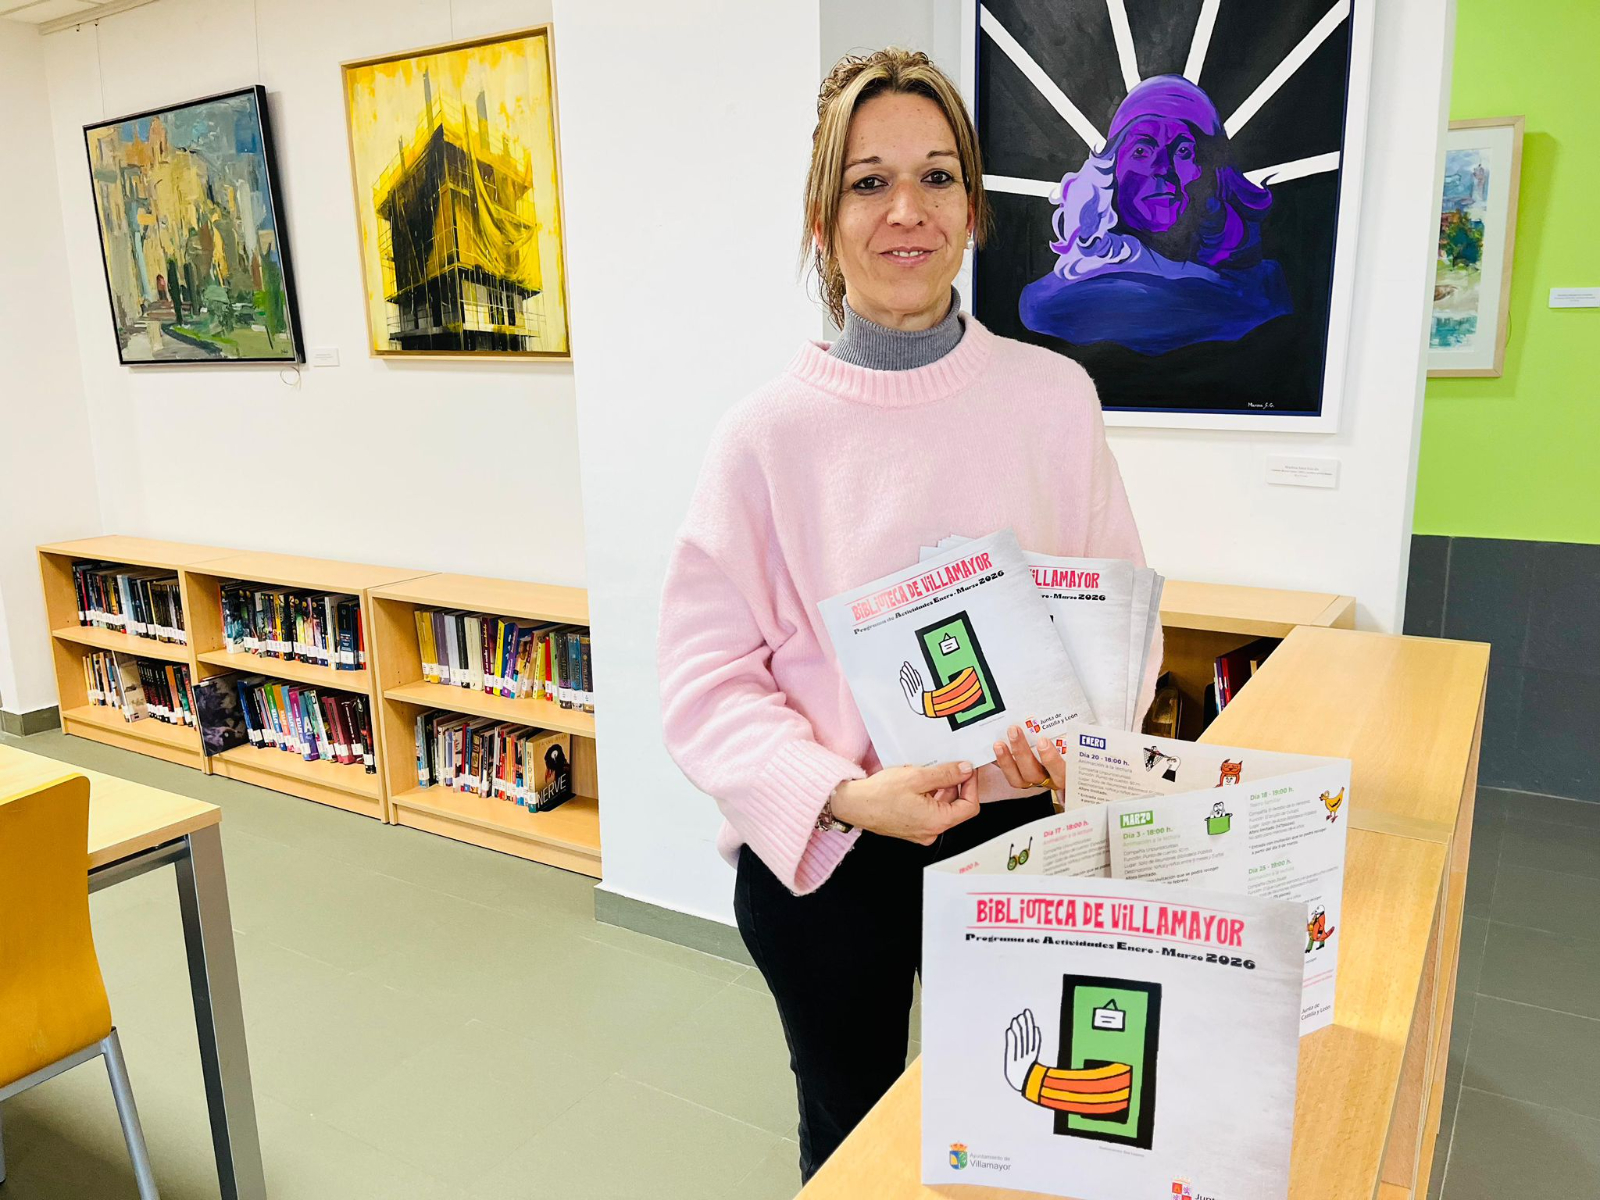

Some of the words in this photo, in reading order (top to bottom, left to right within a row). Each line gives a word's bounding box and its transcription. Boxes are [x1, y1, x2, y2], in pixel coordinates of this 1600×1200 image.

[906, 580, 923, 598] DE
[854, 620, 887, 634] Programa
[895, 601, 933, 619] Actividades
[933, 593, 954, 603] Enero
[956, 583, 979, 595] Marzo
[978, 570, 1005, 585] 2026
[1040, 716, 1054, 725] Junta
[1042, 720, 1060, 730] Castilla
[1065, 713, 1078, 721] León
[1081, 735, 1105, 749] ENERO
[1105, 757, 1122, 765] 18:00
[537, 773, 566, 808] NERVE
[1122, 812, 1151, 826] MARZO
[1123, 832, 1135, 840] Día
[1147, 827, 1165, 836] 18:00
[976, 897, 1077, 928] BiBLiOTECA
[1083, 901, 1104, 928] DE
[1111, 903, 1245, 947] ViLLAMAYOR
[965, 933, 1024, 943] Programa
[1042, 936, 1114, 949] Actividades
[1117, 942, 1154, 954] Enero
[1162, 947, 1203, 961] Marzo
[1206, 953, 1256, 970] 2026
[970, 1160, 1012, 1172] Villamayor
